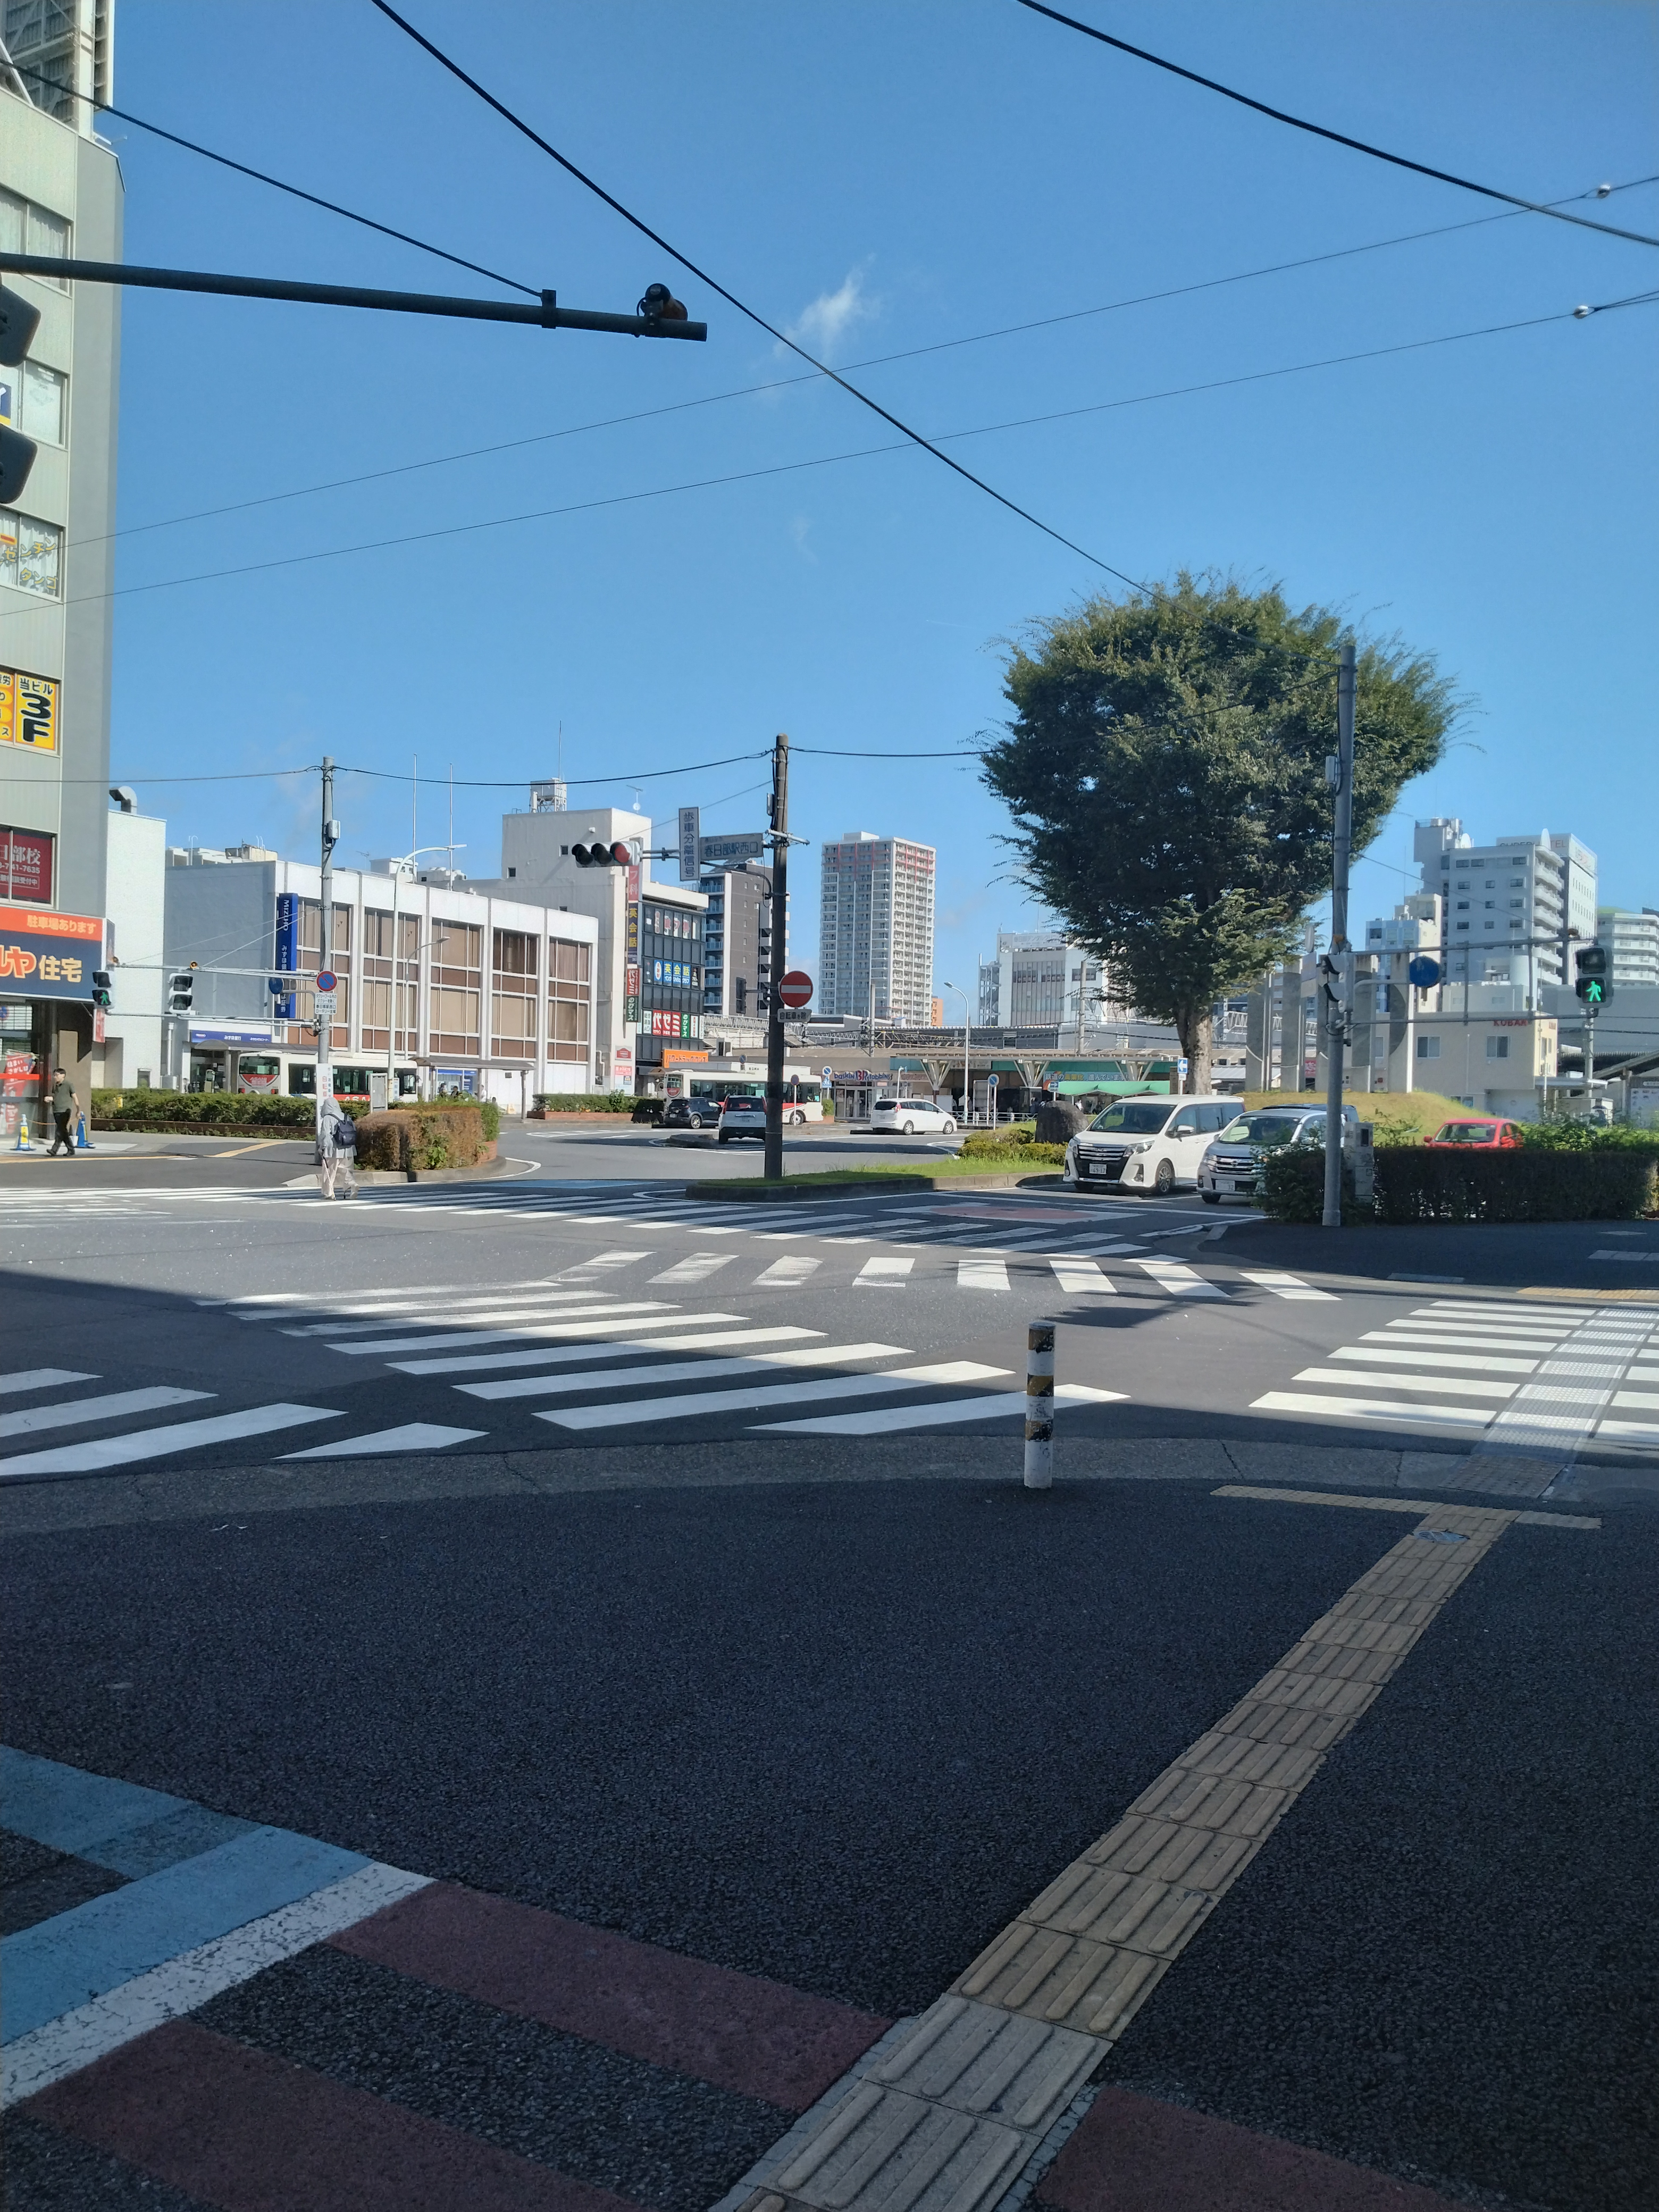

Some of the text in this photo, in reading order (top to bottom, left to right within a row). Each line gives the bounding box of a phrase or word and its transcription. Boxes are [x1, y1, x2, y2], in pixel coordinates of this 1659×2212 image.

[20, 567, 57, 590] タンゴ
[20, 677, 53, 695] 当ビル
[20, 692, 52, 742] 3F
[683, 811, 695, 877] 歩車分離信号
[705, 841, 758, 857] 春日部駅西口
[27, 915, 97, 934] 駐車場あります
[629, 908, 638, 948] 英会話
[39, 954, 82, 983] 住宅
[664, 963, 690, 976] 英会話
[652, 1012, 680, 1030] 代ゼミ
[869, 1072, 892, 1080] robbins
